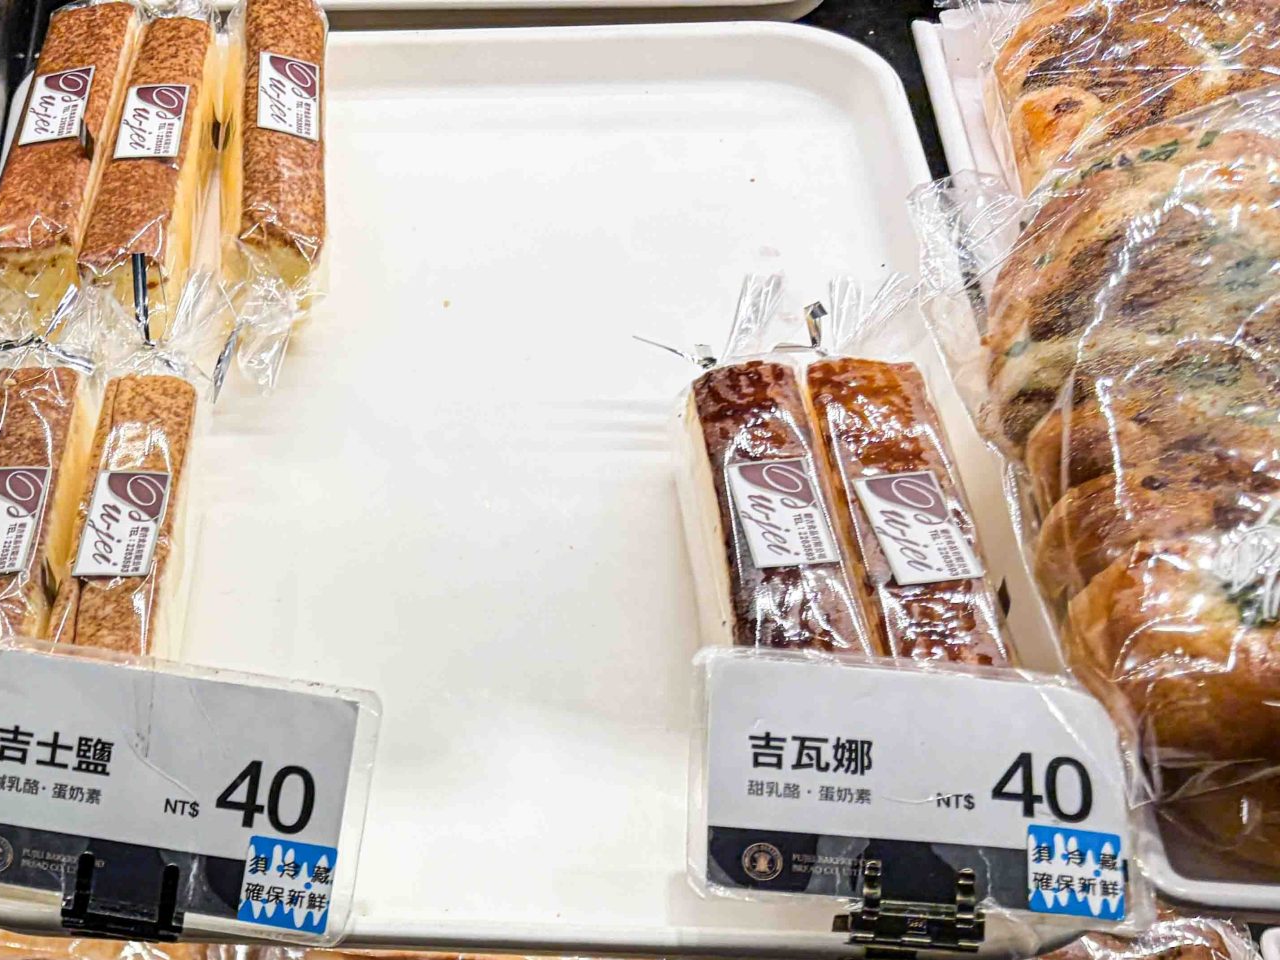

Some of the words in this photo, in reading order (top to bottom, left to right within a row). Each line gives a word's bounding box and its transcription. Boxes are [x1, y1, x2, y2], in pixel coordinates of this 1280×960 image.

[748, 731, 873, 776] 吉瓦娜
[164, 798, 200, 818] NT$
[215, 760, 315, 834] 40
[936, 792, 976, 810] NT$
[991, 752, 1093, 823] 40
[249, 855, 332, 885] 須冷藏
[1032, 845, 1119, 871] 須冷藏
[245, 882, 328, 912] 確保新鮮
[1032, 871, 1120, 896] 確保新鮮
